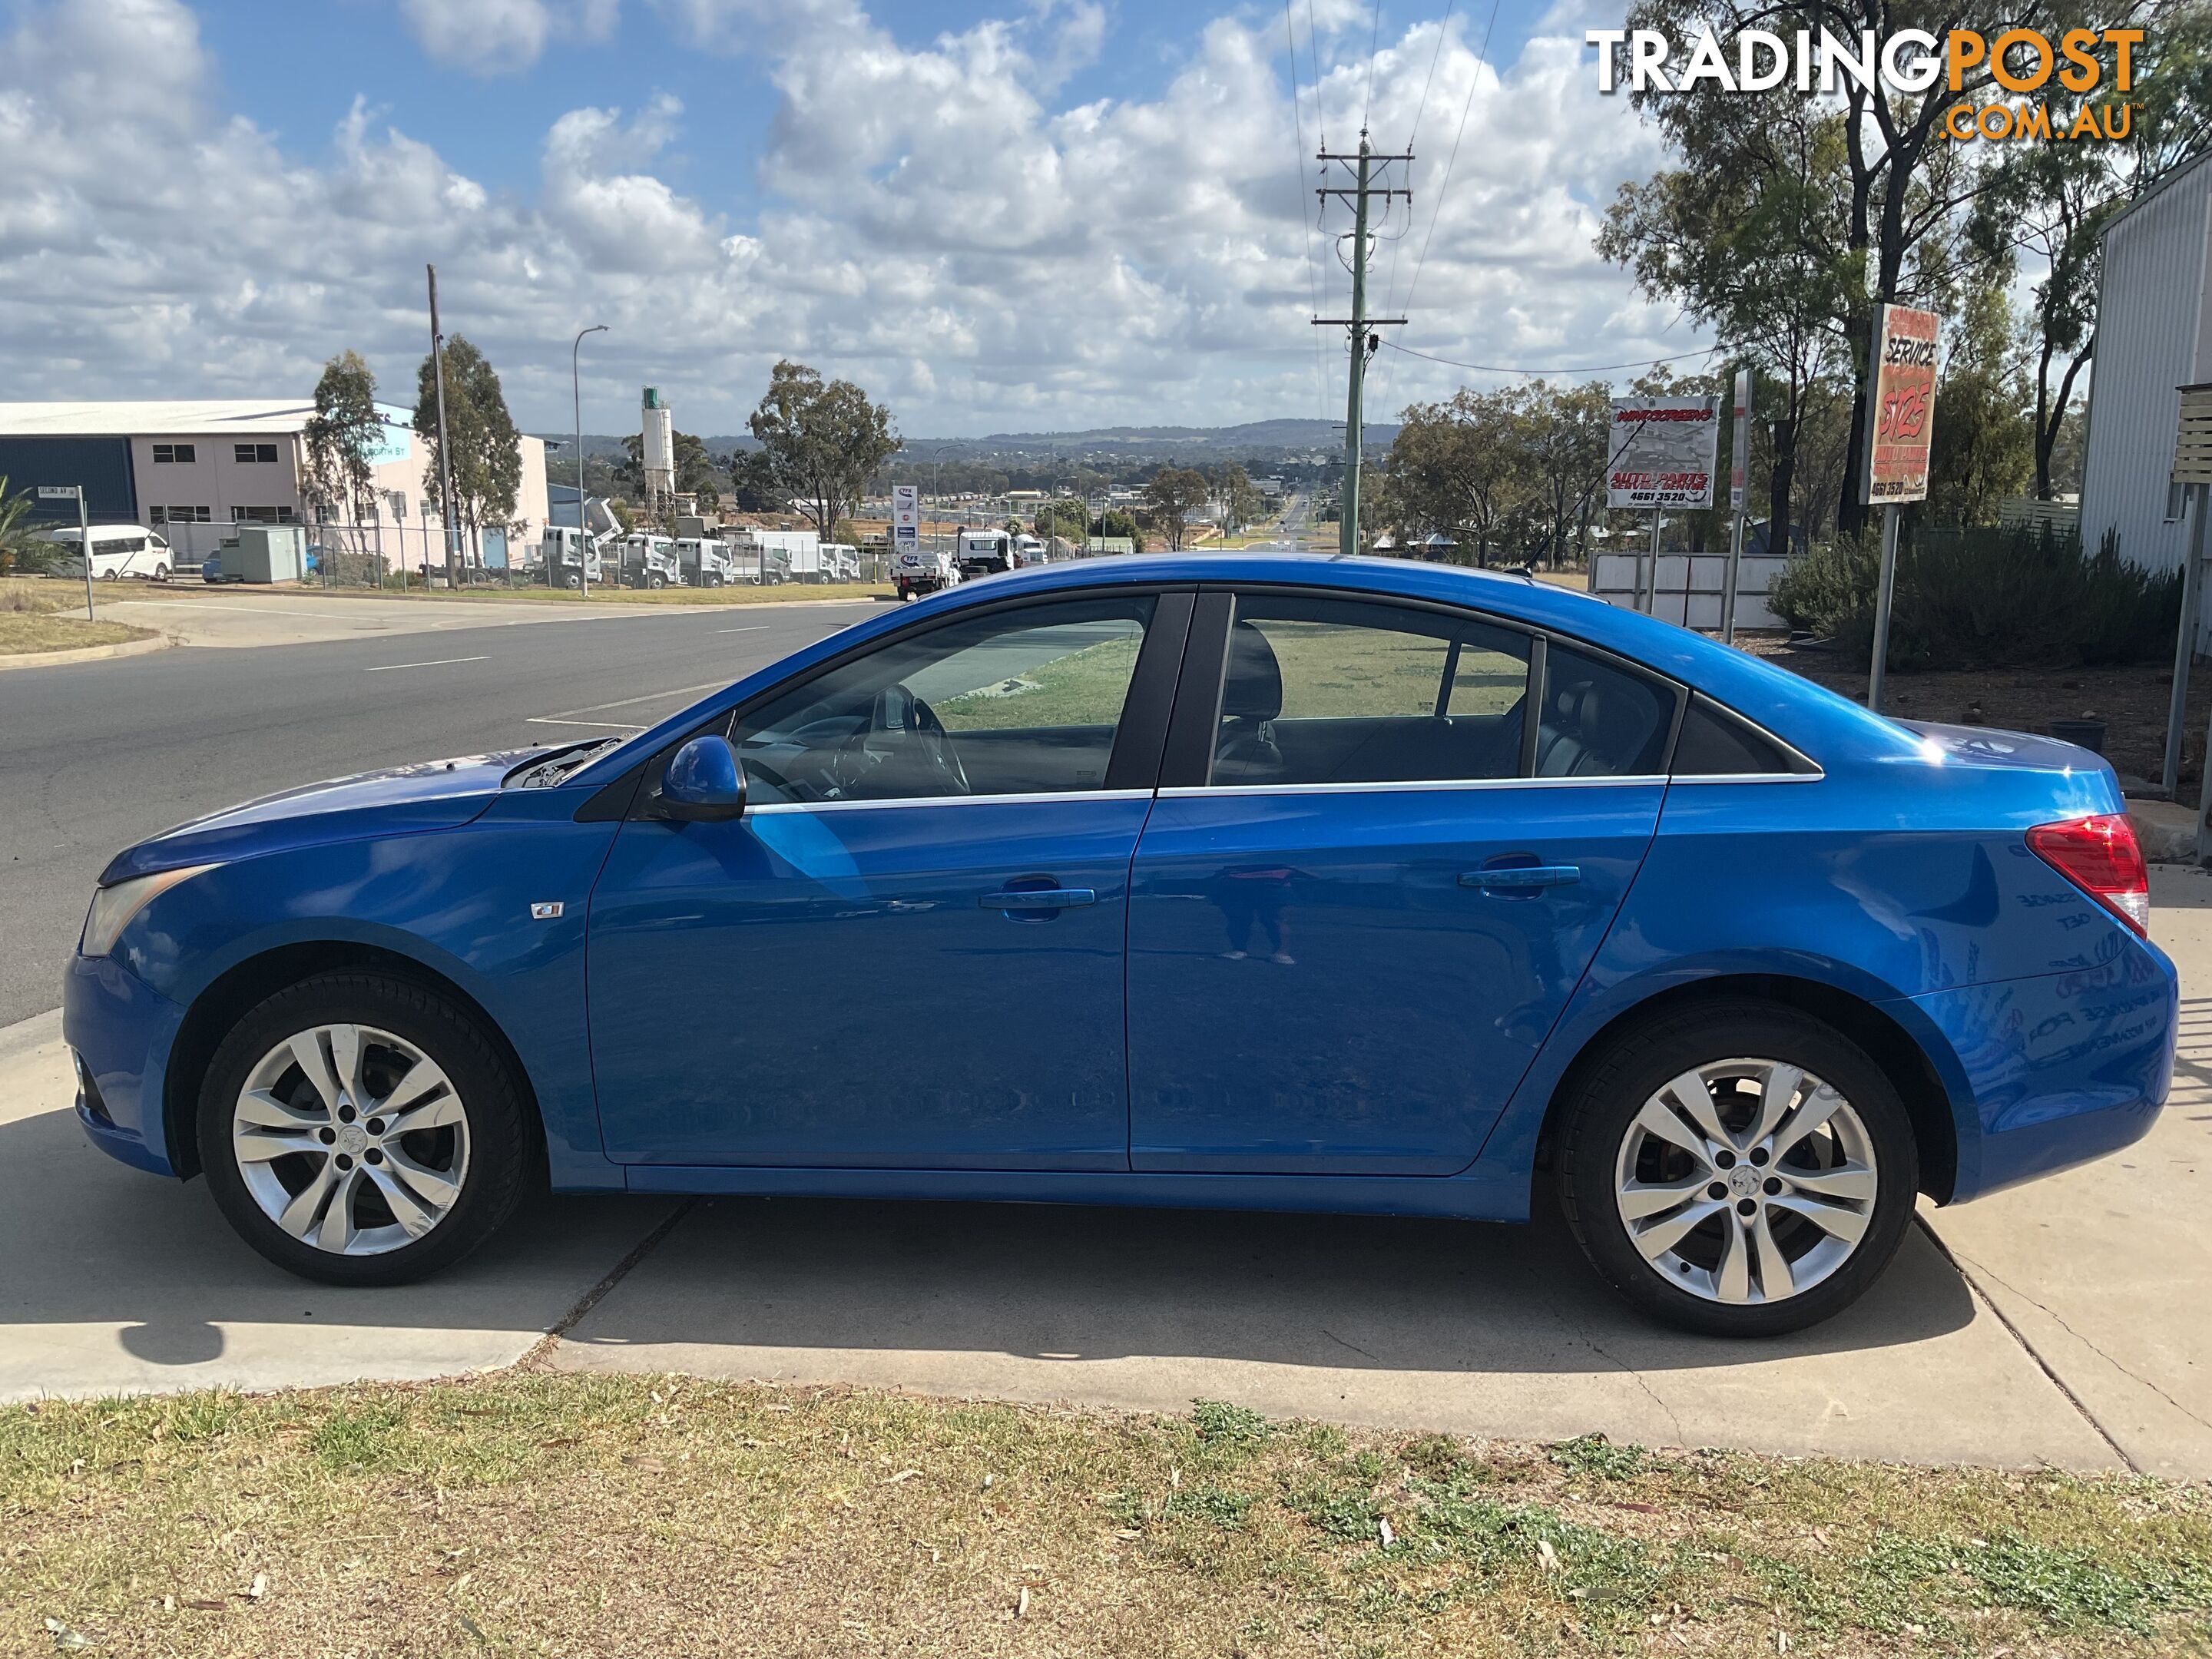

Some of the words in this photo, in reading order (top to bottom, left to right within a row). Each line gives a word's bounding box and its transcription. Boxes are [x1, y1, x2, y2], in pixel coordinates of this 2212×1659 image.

[1886, 338, 1936, 366] SERVICE
[1617, 409, 1714, 422] WINDSCREENS
[1611, 472, 1651, 482] AUTO
[1657, 472, 1709, 483] PARTS
[1611, 482, 1658, 490] SERVICE
[1872, 482, 1886, 496] 4661
[1887, 482, 1904, 495] 3520
[1630, 492, 1654, 501] 4661
[1657, 492, 1686, 501] 3520
